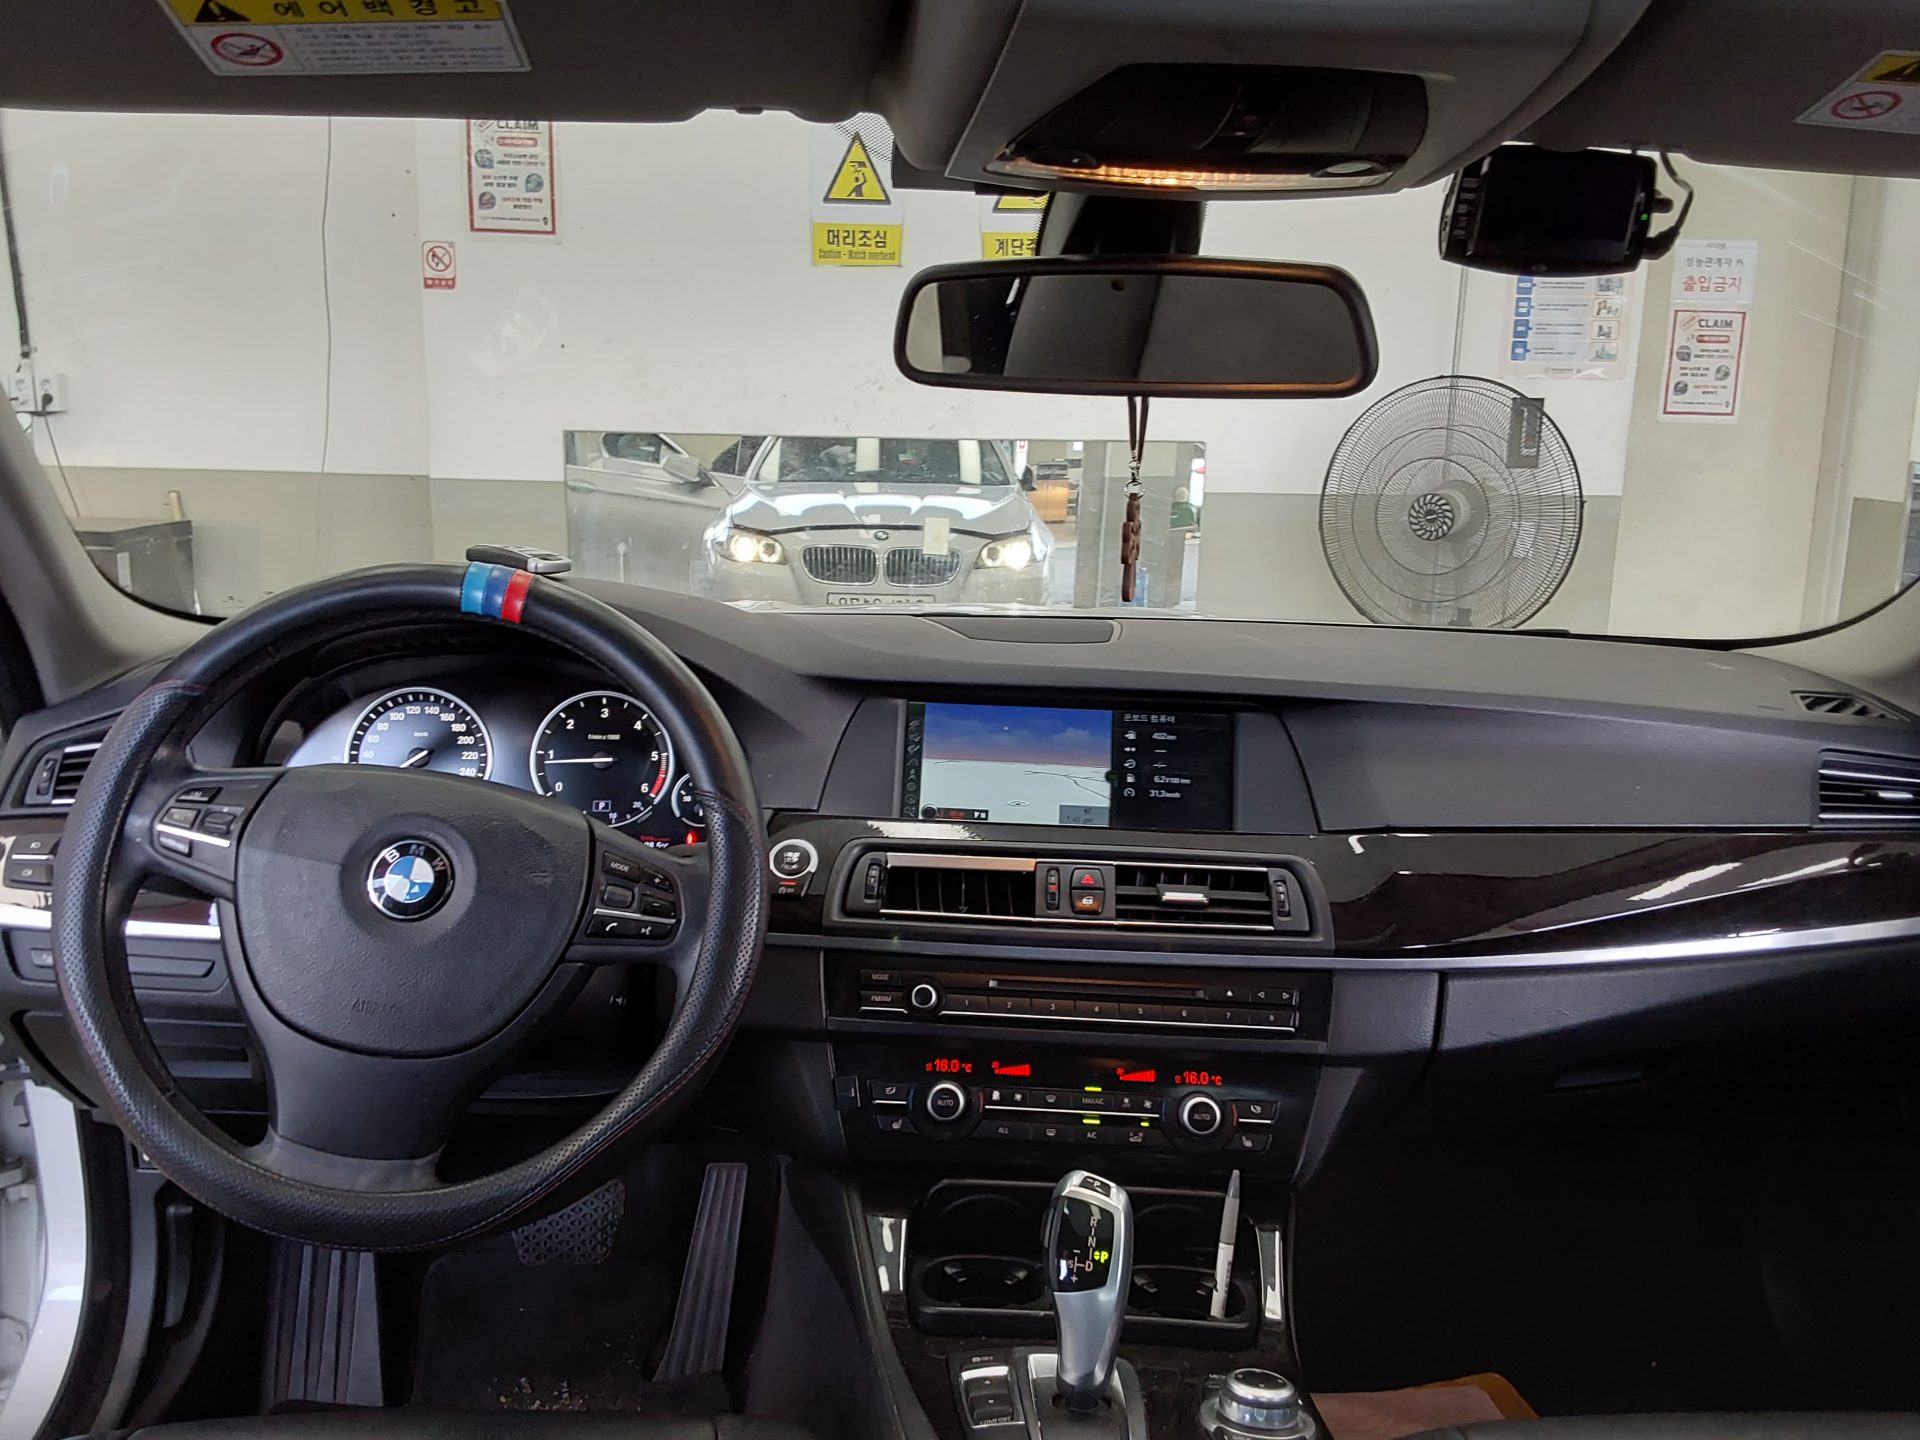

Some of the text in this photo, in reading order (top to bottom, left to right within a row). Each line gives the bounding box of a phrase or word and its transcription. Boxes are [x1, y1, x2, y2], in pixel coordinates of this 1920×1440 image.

[827, 229, 887, 249] 머리조심
[1682, 275, 1742, 293] 출입금지
[1698, 319, 1733, 328] CLAIM
[405, 706, 421, 715] 120
[424, 706, 440, 715] 140
[600, 708, 609, 718] 3
[389, 713, 405, 721] 100
[439, 713, 455, 722] 160
[377, 722, 389, 731] 80
[450, 723, 466, 732] 180
[565, 719, 575, 730] 2
[633, 720, 642, 731] 4
[457, 736, 475, 745] 200
[363, 751, 374, 759] 40
[461, 751, 479, 760] 220
[547, 749, 554, 759] 1
[650, 751, 659, 761] 5
[459, 768, 476, 777] 240
[554, 782, 563, 792] 0
[640, 783, 649, 793] 6
[384, 843, 447, 872] BMW
[610, 861, 630, 872] MODE
[1006, 1001, 1012, 1009] 2
[1137, 1007, 1143, 1015] 5
[1181, 1009, 1187, 1017] 6
[1225, 1011, 1231, 1019] 7
[997, 1126, 1009, 1134] ALL
[1090, 1216, 1097, 1228] R
[1087, 1236, 1096, 1248] N
[1100, 1251, 1109, 1264] P
[1067, 1260, 1093, 1272] S D
